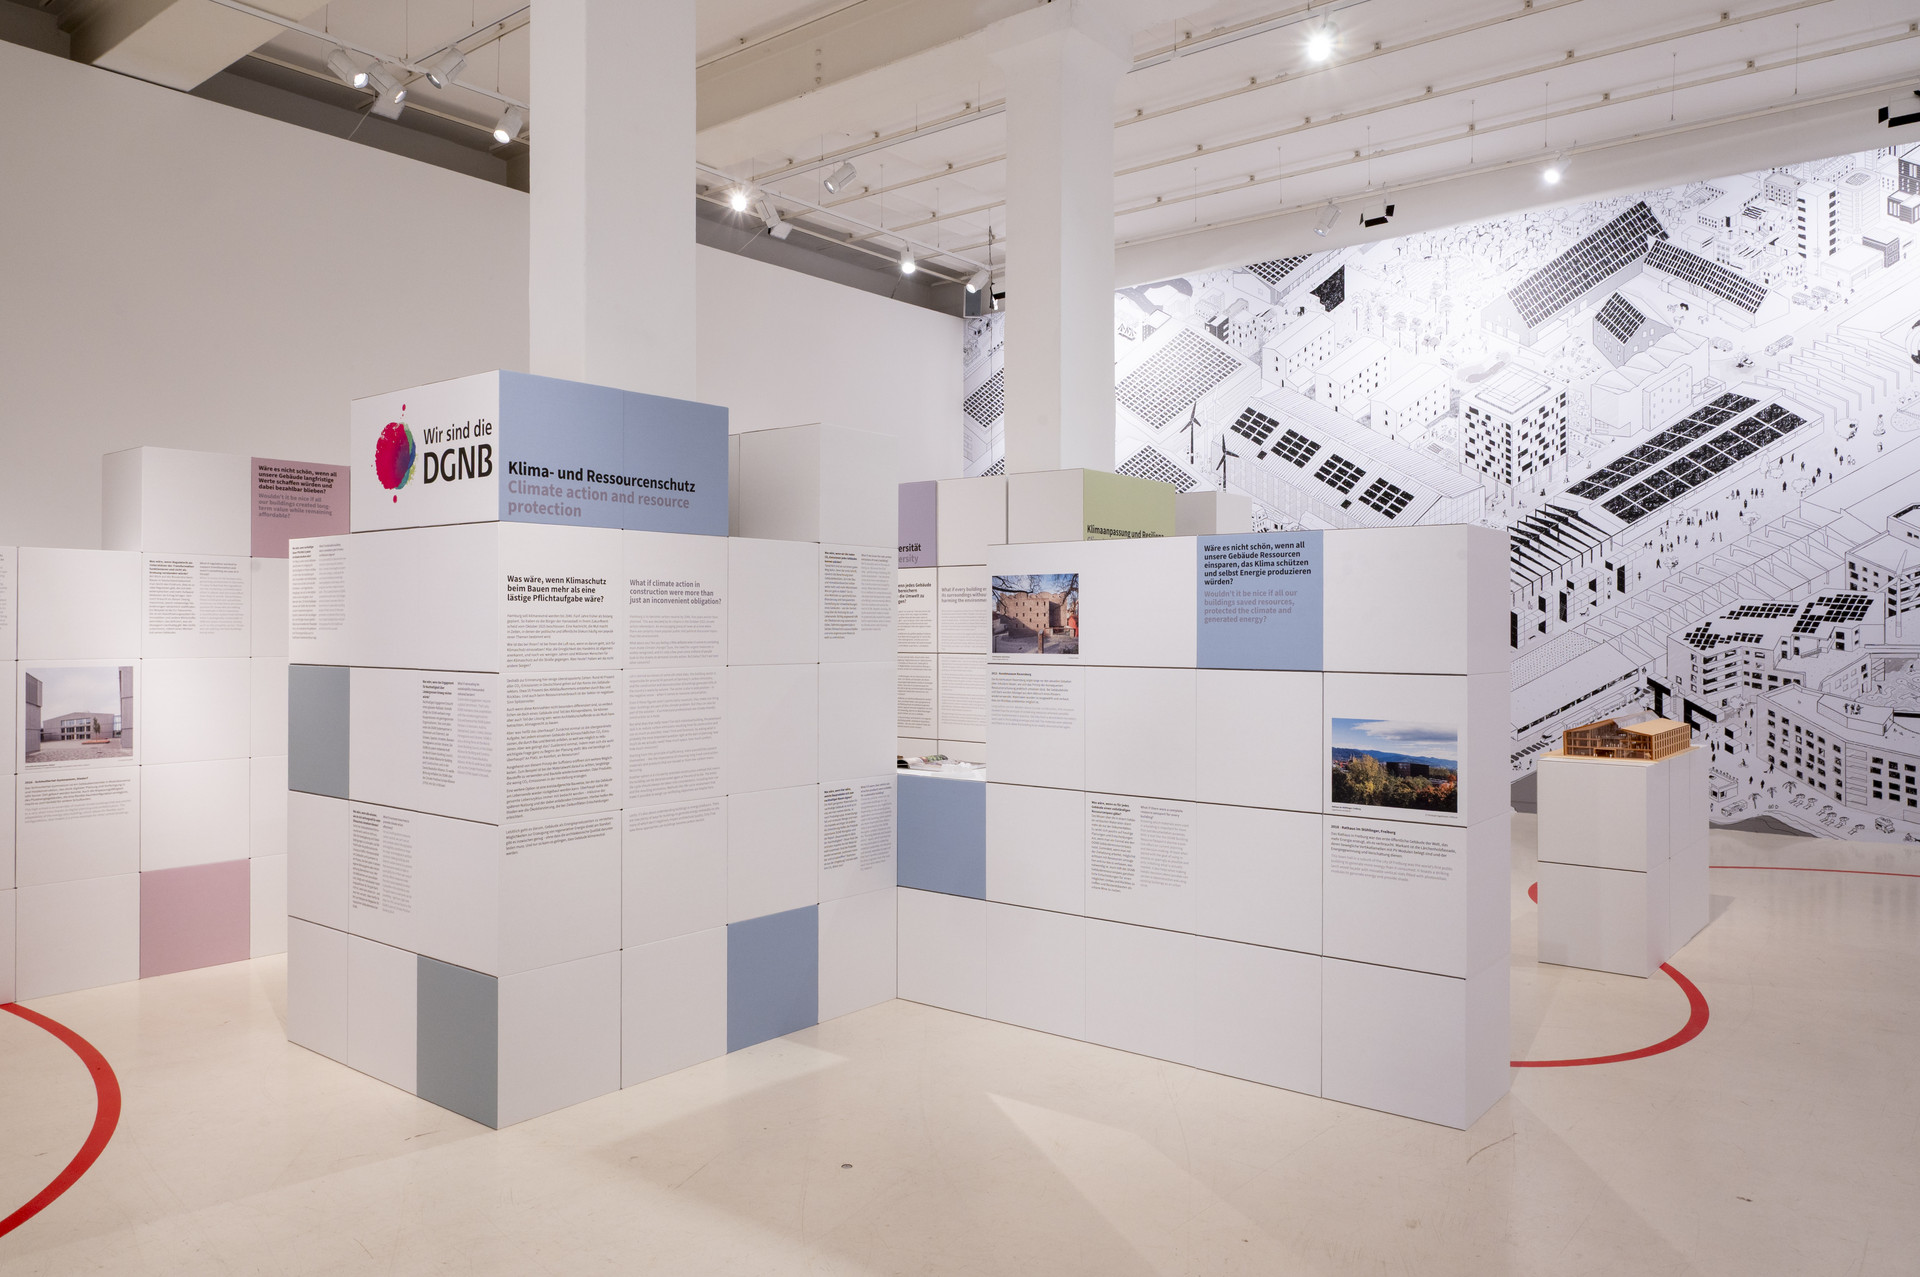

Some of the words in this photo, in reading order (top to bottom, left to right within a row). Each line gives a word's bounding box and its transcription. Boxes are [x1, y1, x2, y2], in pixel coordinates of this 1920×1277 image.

[424, 427, 443, 444] Wir
[447, 420, 469, 441] sind
[474, 419, 492, 438] die
[423, 443, 493, 484] DGNB
[508, 461, 554, 479] Klima-
[558, 467, 583, 482] und
[587, 469, 696, 493] Ressourcenschutz
[508, 480, 562, 498] Climate
[567, 485, 608, 502] action
[611, 489, 634, 504] and
[638, 494, 689, 508] resource
[508, 499, 581, 518] protection
[1087, 524, 1131, 539] Klimaanpassung
[1132, 530, 1141, 538] und
[898, 543, 921, 552] ersität
[1204, 543, 1221, 552] Wäre
[1231, 542, 1248, 551] nicht
[1250, 542, 1273, 551] schön,
[1228, 551, 1258, 560] Gebäude
[1204, 561, 1240, 570] einsparen,
[1240, 568, 1266, 577] Energie
[1267, 568, 1311, 577] produzieren
[524, 575, 544, 584] wäre,
[566, 577, 607, 585] Klimaschutz
[1204, 577, 1233, 586] würden?
[507, 593, 531, 602] lästige
[533, 594, 582, 604] Pflichtaufgabe
[1204, 590, 1234, 598] Wouldn't
[629, 596, 642, 604] just
[691, 598, 721, 606] obligation?
[1204, 599, 1235, 607] buildings
[1204, 607, 1237, 615] protected
[1204, 616, 1237, 624] generated
[1239, 615, 1267, 624] energy?
